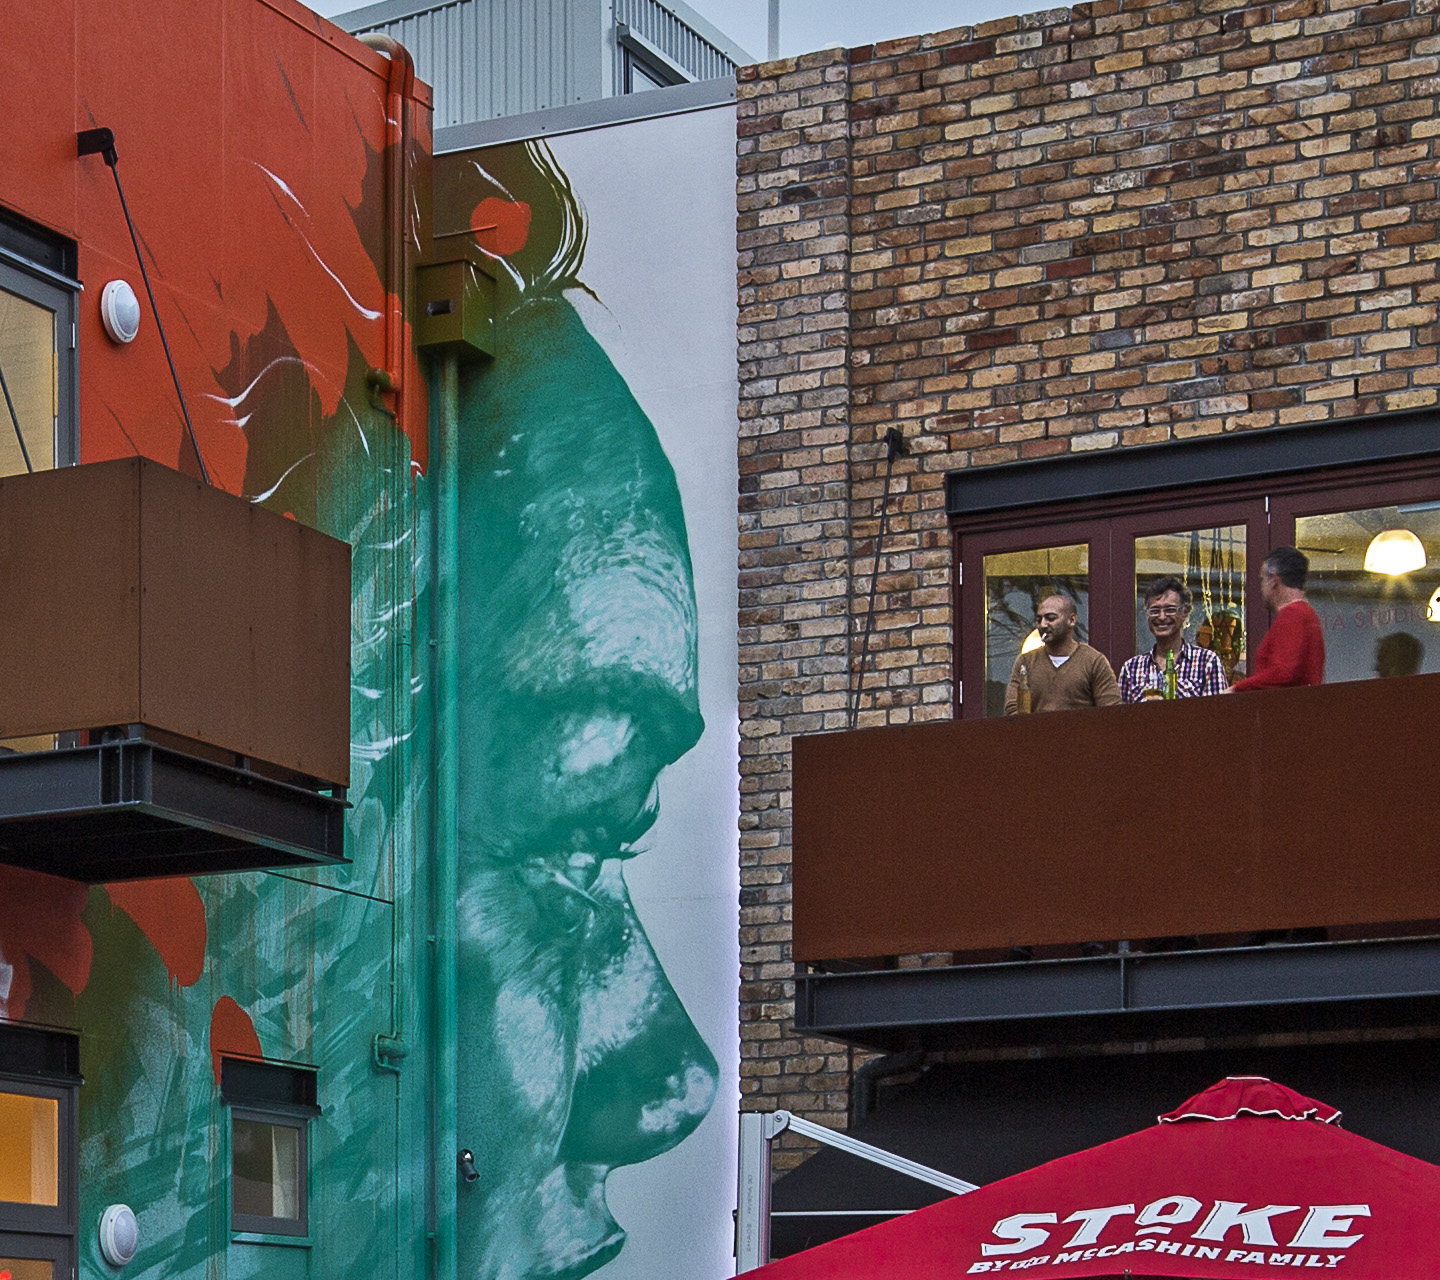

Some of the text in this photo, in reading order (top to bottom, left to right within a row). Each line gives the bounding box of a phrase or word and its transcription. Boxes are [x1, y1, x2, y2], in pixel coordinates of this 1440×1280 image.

[1354, 604, 1433, 629] STUDIO
[981, 1195, 1372, 1257] STOKE
[966, 1259, 1011, 1274] BY
[1223, 1248, 1346, 1269] FAMILY
